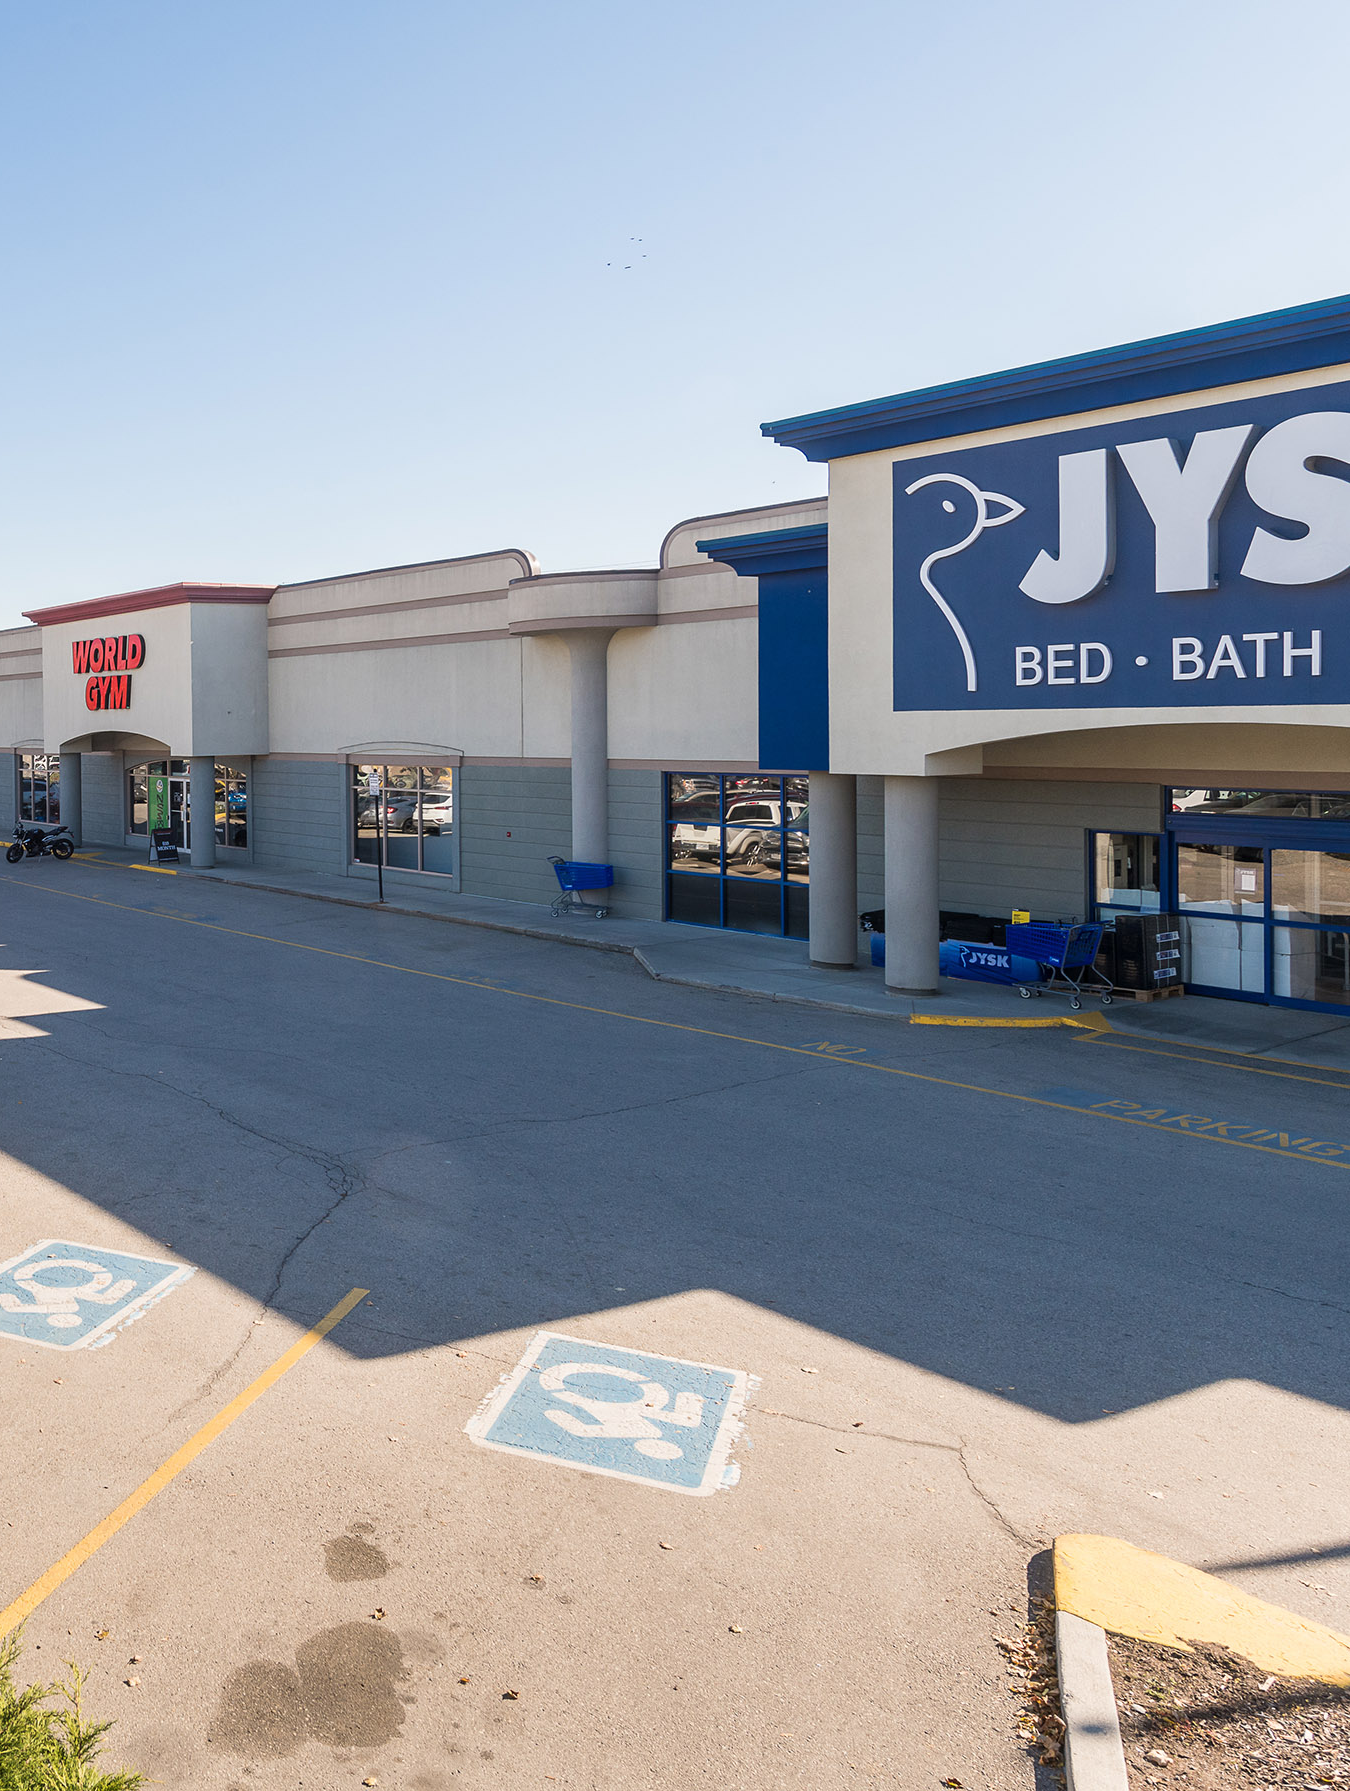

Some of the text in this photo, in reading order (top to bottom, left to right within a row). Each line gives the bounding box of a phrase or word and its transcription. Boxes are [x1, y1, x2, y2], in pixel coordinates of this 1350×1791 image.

[1018, 411, 1350, 604] JYS
[72, 634, 146, 674] WORLD
[1015, 630, 1322, 687] BED BATH
[86, 674, 132, 711] GYM
[155, 794, 164, 830] ZUMB
[969, 951, 1010, 968] JYSK
[800, 1041, 867, 1056] NO
[1089, 1100, 1350, 1156] PARKING
